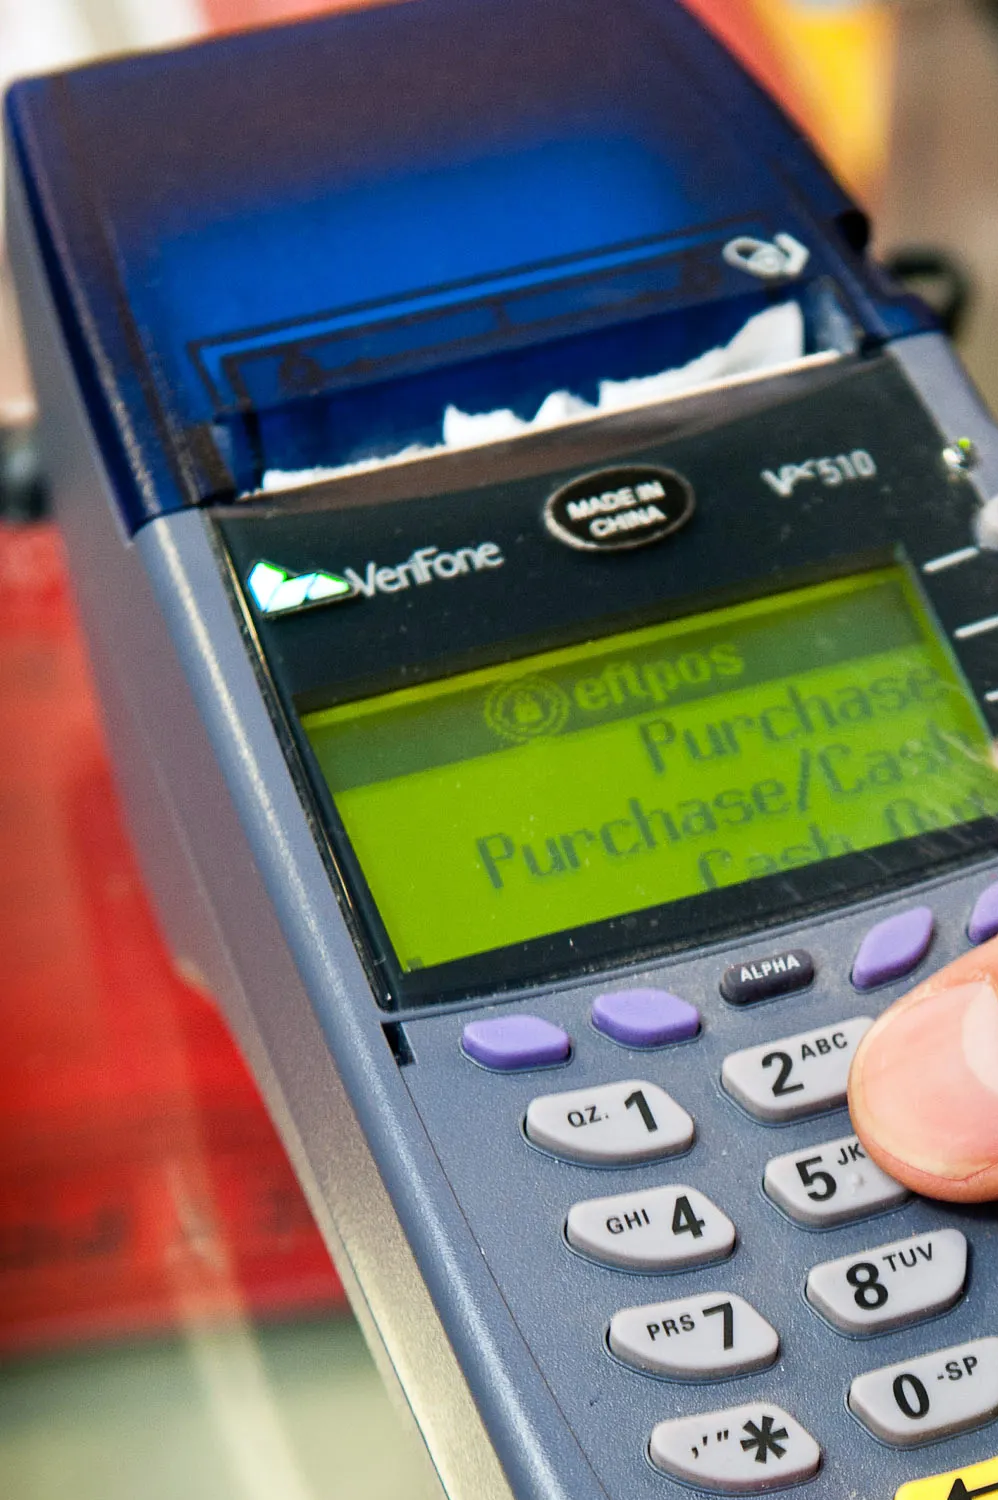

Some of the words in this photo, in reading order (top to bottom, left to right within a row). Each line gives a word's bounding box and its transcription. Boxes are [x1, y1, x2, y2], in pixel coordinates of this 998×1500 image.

[566, 486, 637, 522] MADE
[634, 480, 666, 503] IN
[589, 504, 668, 538] CHINA
[345, 541, 504, 598] VeriFone
[573, 642, 746, 711] eftpos
[638, 664, 947, 776] Purchase
[739, 953, 801, 983] ALPHA
[761, 1051, 805, 1097] 2
[800, 1031, 849, 1062] ABC
[623, 1089, 659, 1133] 1
[795, 1155, 838, 1202] 5
[836, 1142, 865, 1167] JK
[605, 1208, 651, 1235] GHI
[671, 1194, 706, 1239] 4
[845, 1261, 889, 1310] 8
[882, 1243, 934, 1273] TUV
[646, 1314, 696, 1341] PRS
[702, 1301, 734, 1351] 7
[892, 1373, 930, 1421] 0
[936, 1356, 979, 1382] -SP
